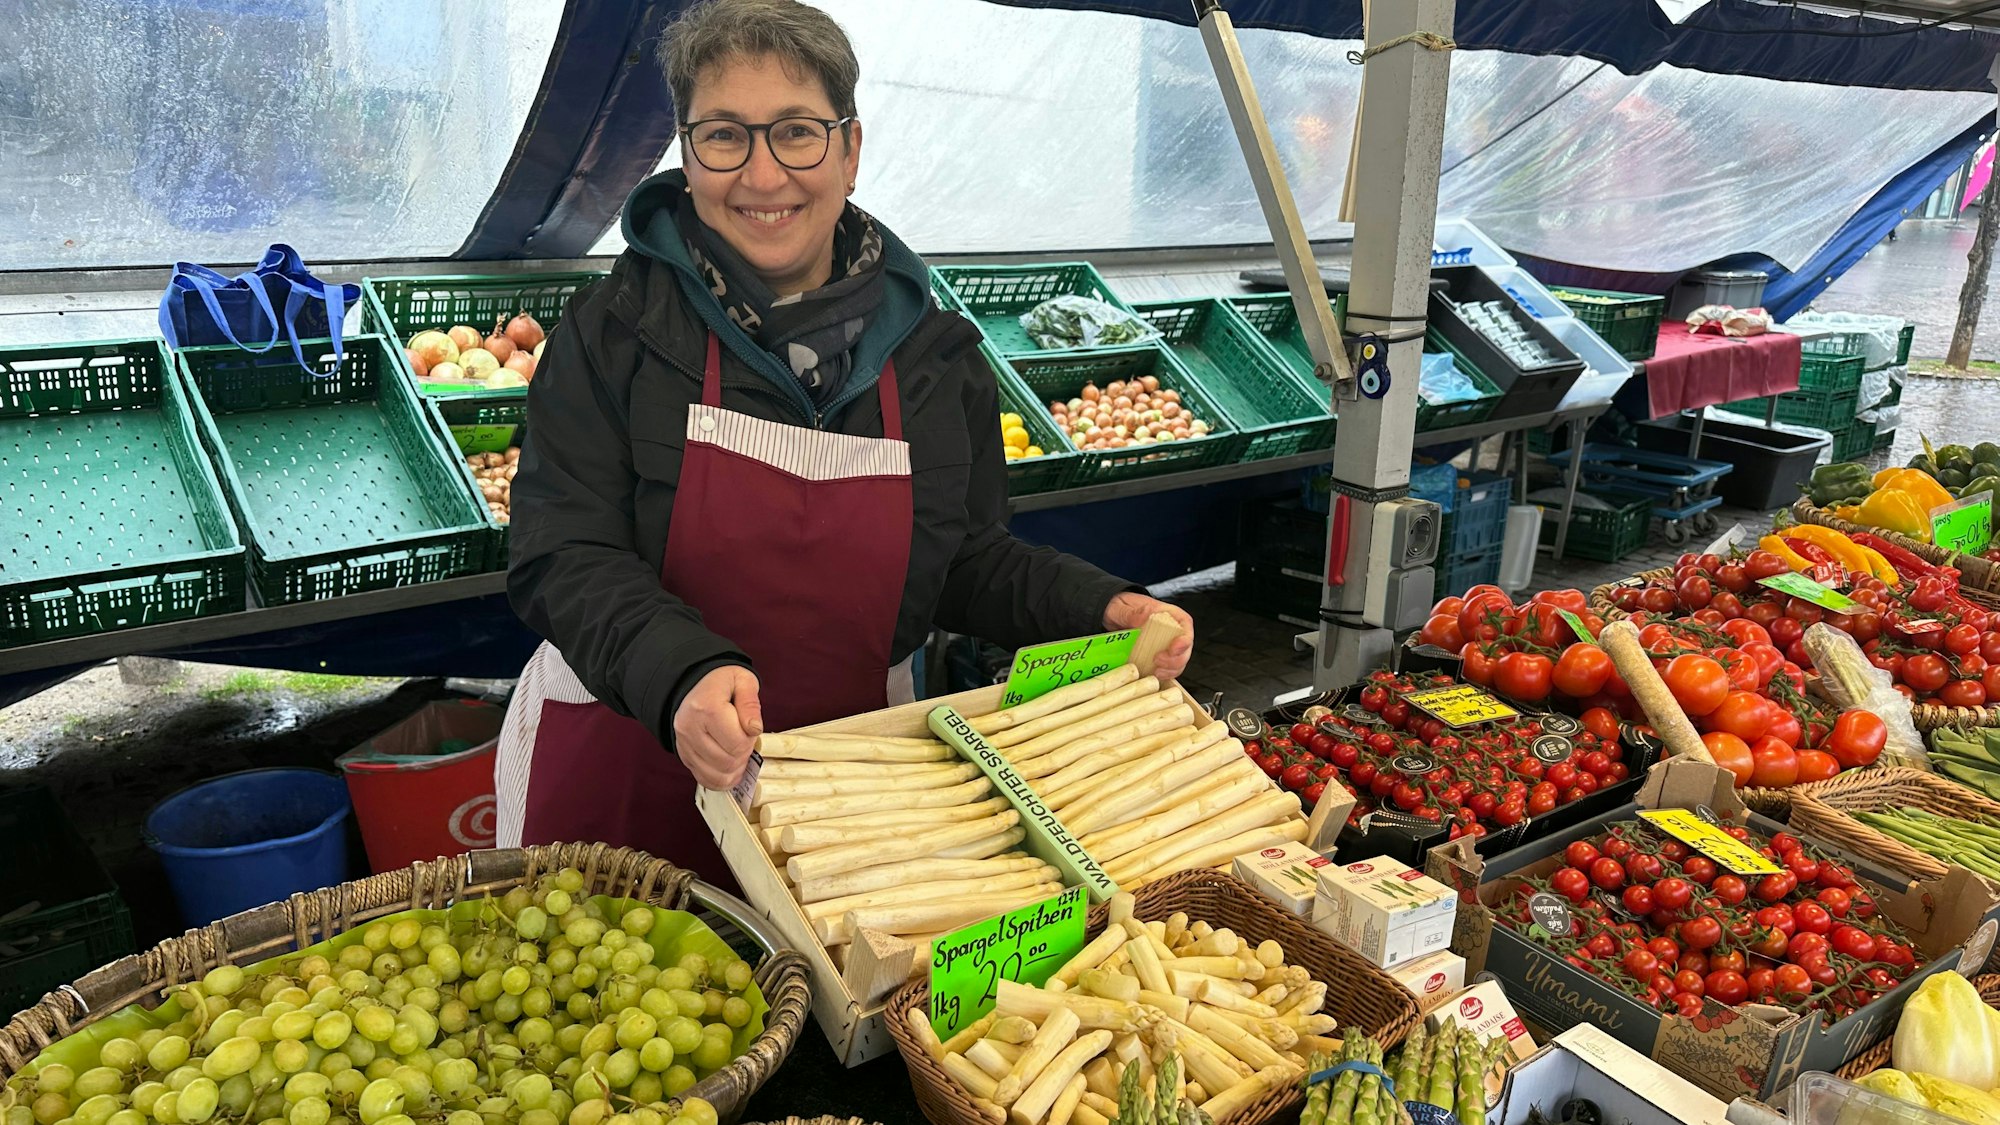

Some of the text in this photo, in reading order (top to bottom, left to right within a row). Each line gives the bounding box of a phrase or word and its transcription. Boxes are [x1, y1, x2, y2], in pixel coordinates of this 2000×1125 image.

[1967, 520, 1981, 544] 10
[1105, 632, 1131, 644] 1270
[1016, 639, 1093, 679] Spargel
[1091, 663, 1109, 674] 00
[1004, 691, 1023, 706] 1kg
[943, 709, 1112, 889] WALDFEUCHTER SPARGEL
[1058, 889, 1081, 907] 1271
[978, 942, 1047, 1008] 20 00
[1525, 951, 1624, 1030] Umami
[933, 991, 960, 1031] 1kg
